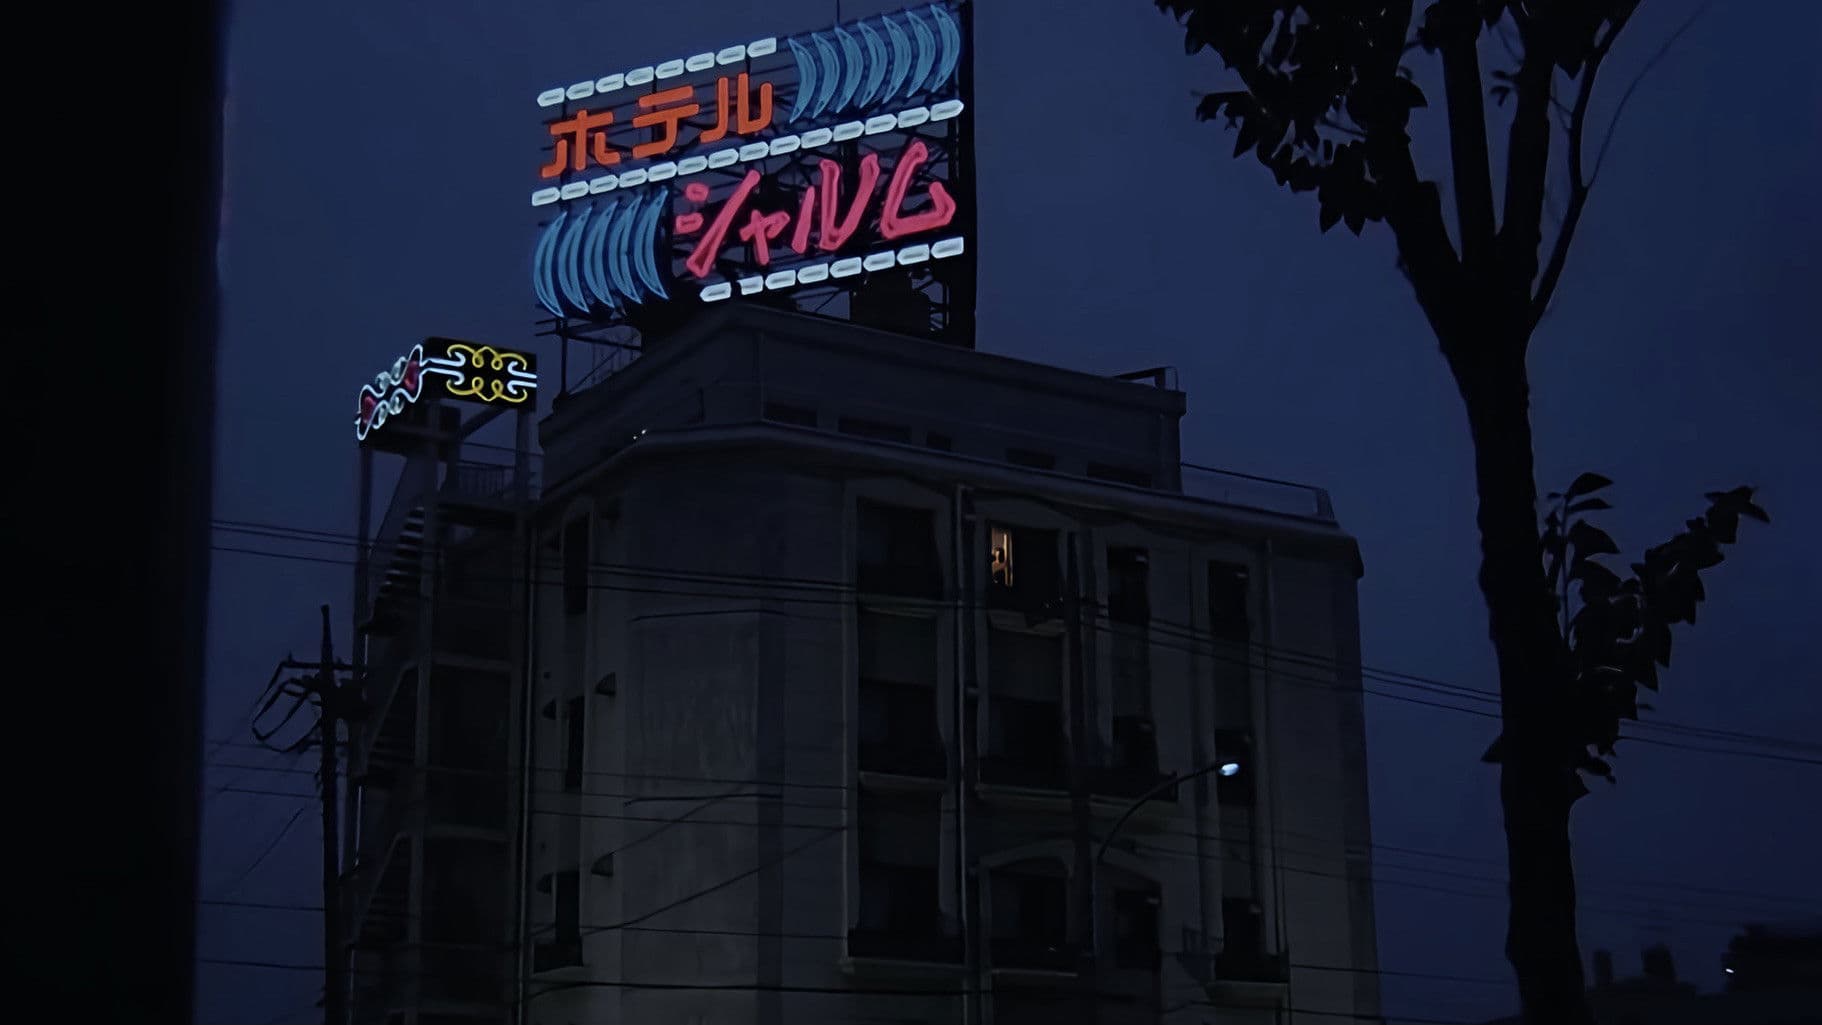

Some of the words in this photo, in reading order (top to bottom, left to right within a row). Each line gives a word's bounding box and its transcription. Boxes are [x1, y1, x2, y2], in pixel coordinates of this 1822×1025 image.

[540, 72, 773, 179] ホテル
[675, 139, 957, 278] シャルム
